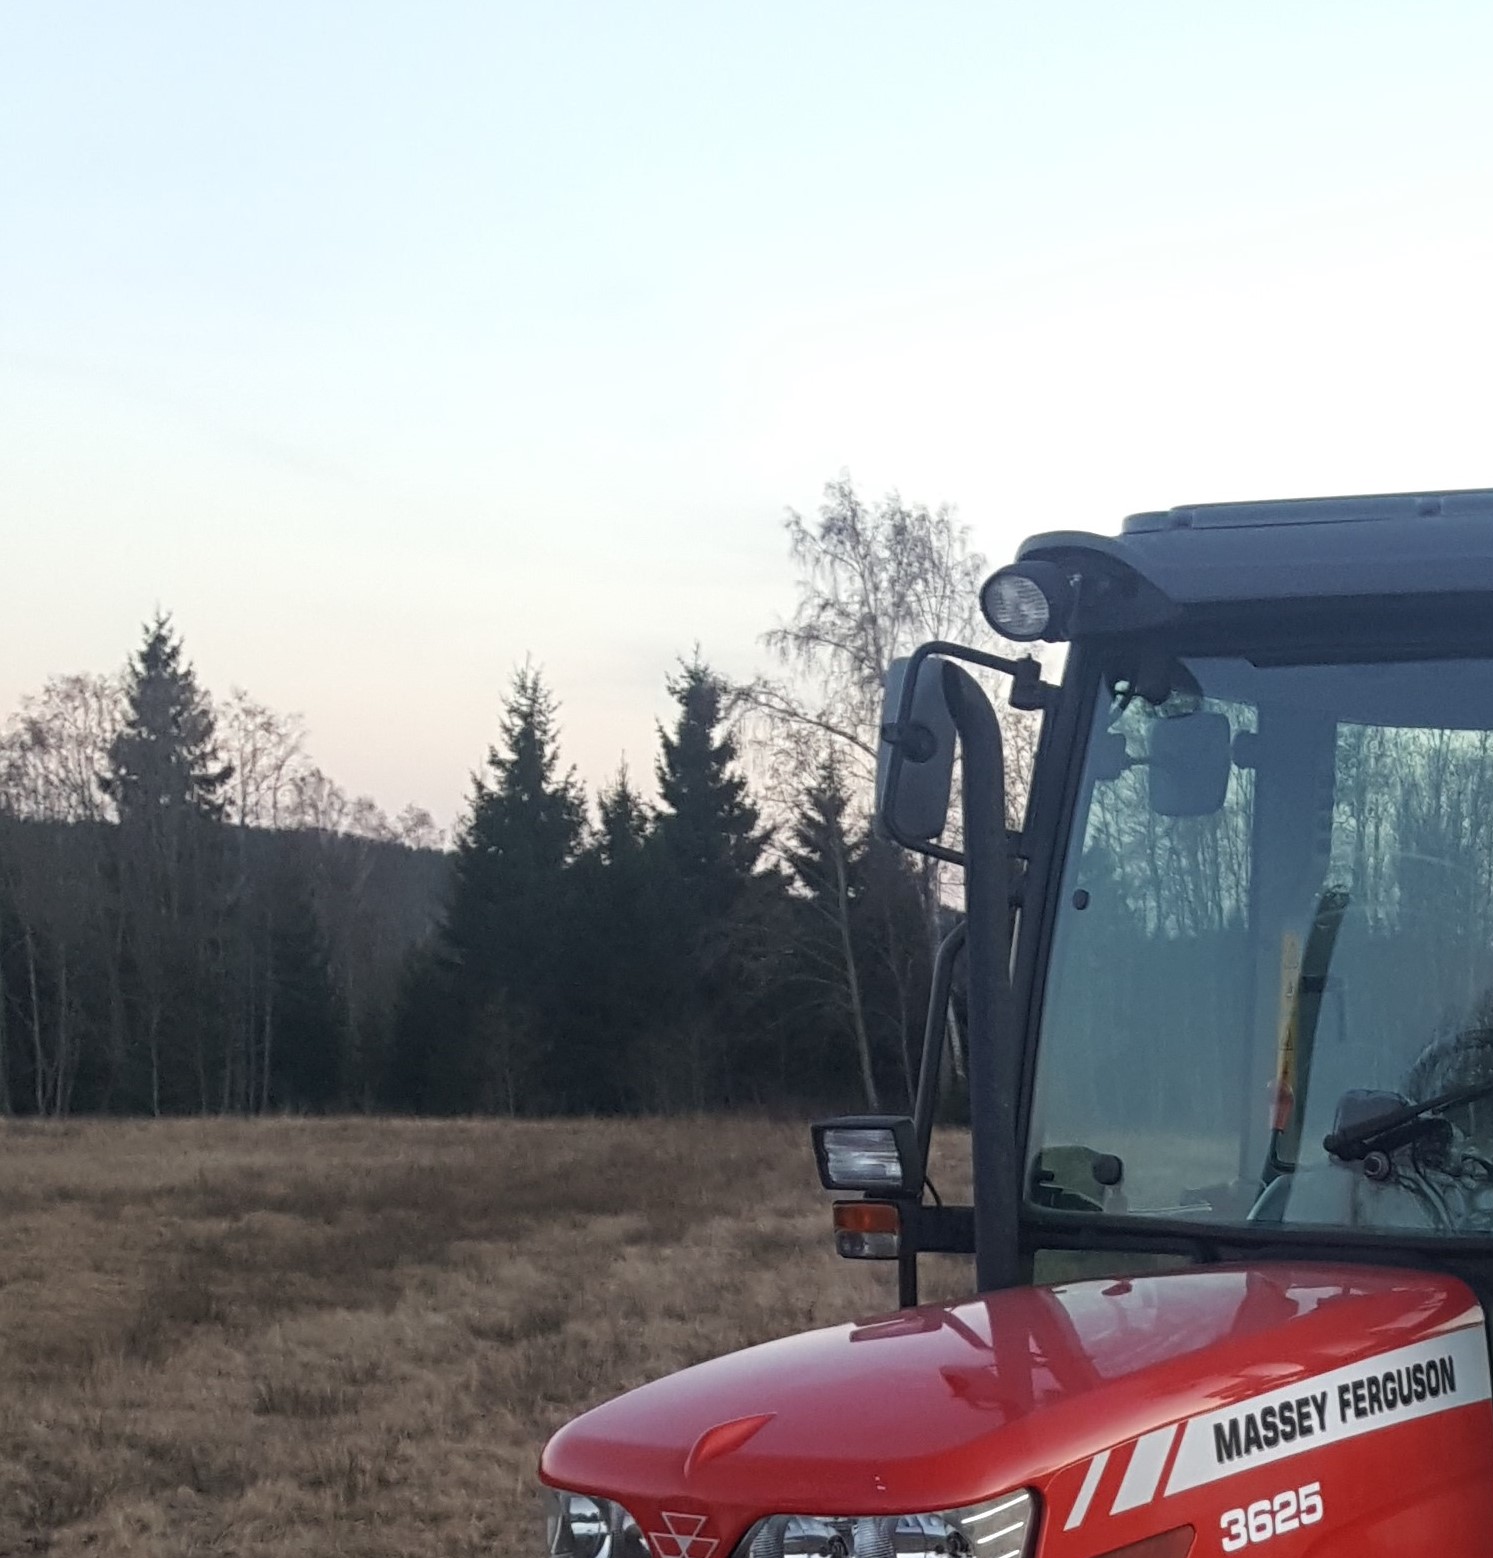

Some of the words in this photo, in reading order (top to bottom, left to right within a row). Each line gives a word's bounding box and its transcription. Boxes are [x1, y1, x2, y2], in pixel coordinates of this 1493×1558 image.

[1213, 1391, 1327, 1464] MASSEY
[1337, 1355, 1456, 1423] FERGUSON
[1220, 1482, 1324, 1553] 3625
